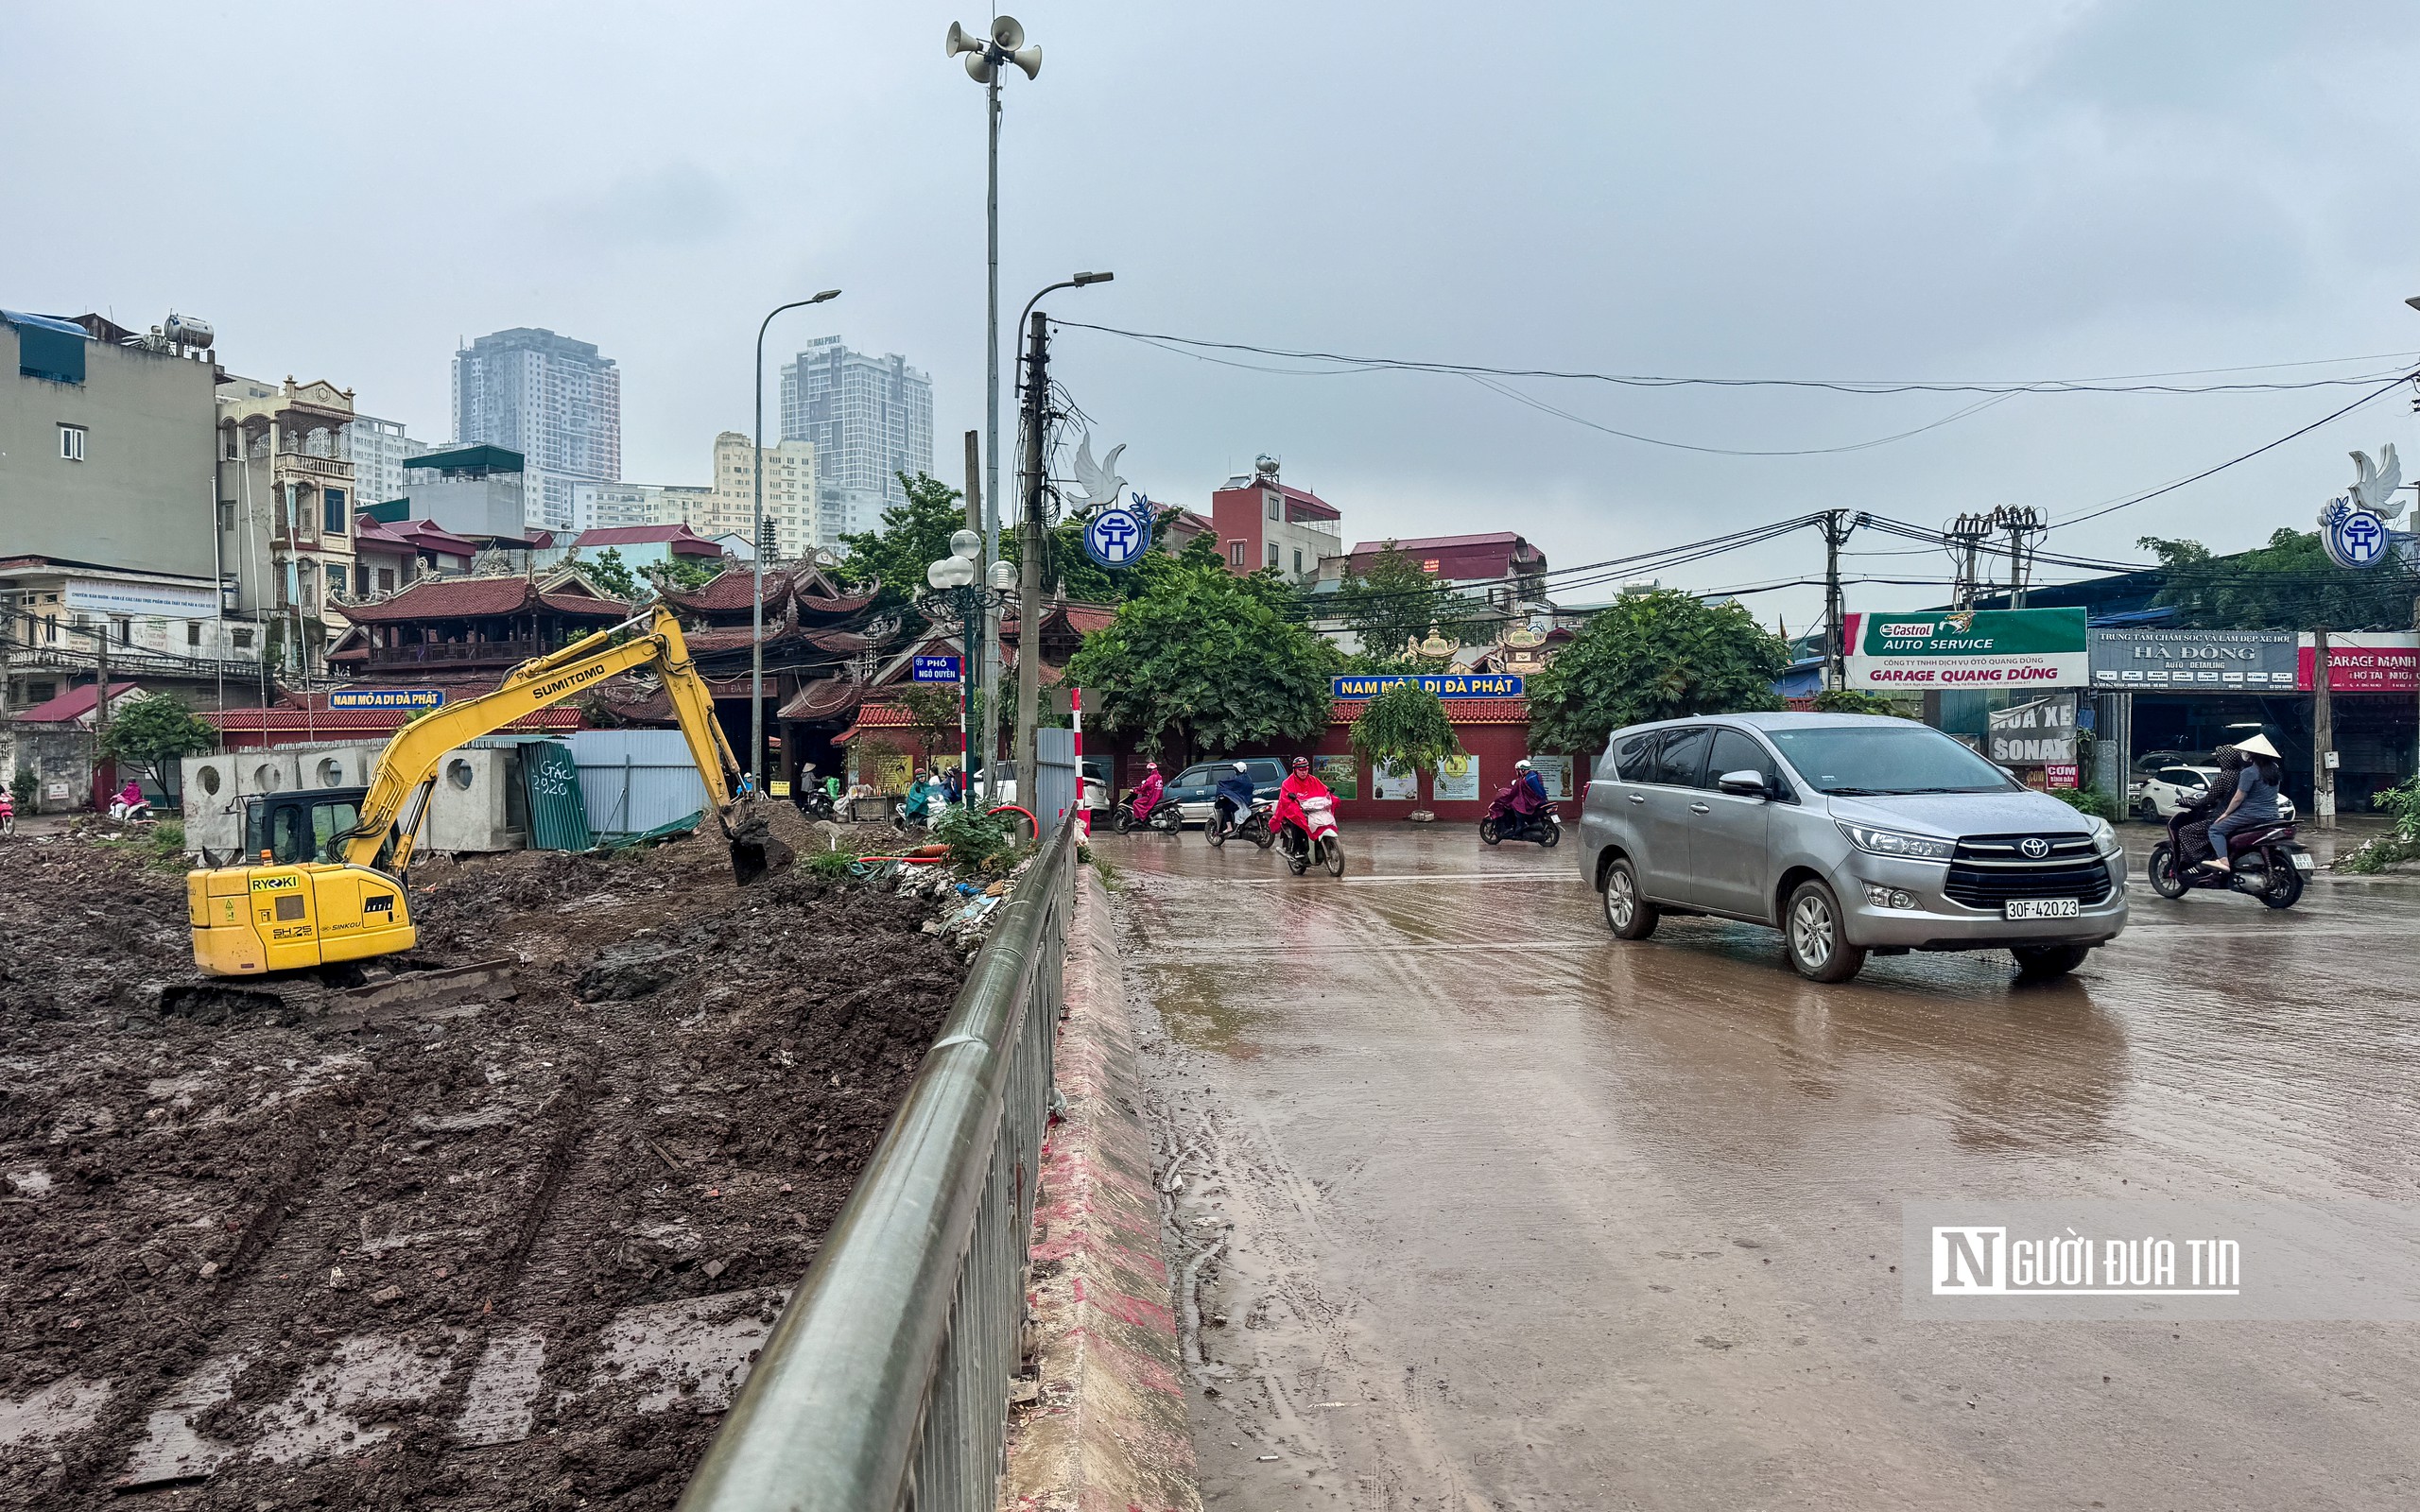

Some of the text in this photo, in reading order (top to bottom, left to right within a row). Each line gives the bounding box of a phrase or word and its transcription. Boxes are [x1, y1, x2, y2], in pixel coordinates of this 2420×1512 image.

[1893, 625, 1930, 636] Castrol
[2134, 632, 2153, 641] TÂM
[2155, 633, 2182, 642] CHĂM
[2183, 633, 2203, 642] SÓC
[2204, 633, 2217, 642] VÀ
[2219, 633, 2238, 642] LÀM
[1883, 639, 1994, 650] AUTO SERVICE
[2135, 643, 2256, 660] HÀ ĐÔNG
[927, 658, 947, 667] PHỐ
[2327, 656, 2417, 670] GARAGE MẠNH
[934, 667, 956, 679] QUYỀN
[1870, 666, 2058, 682] GARAGE QUANG DŨNG
[532, 664, 605, 699] SUMITOMO
[731, 682, 742, 693] ĐÀ
[747, 683, 768, 693] PT
[1341, 681, 1377, 695] NAM
[1425, 680, 1441, 693] DI
[1444, 677, 1467, 693] ĐÀ
[1472, 677, 1513, 696] PHẬT
[334, 691, 439, 707] NAM MÔ A DI ĐÀ PHẬT
[2045, 704, 2072, 728] XE
[1994, 738, 2071, 761] SONAX
[2048, 766, 2076, 776] CƠM
[2008, 901, 2077, 918] 30F-420.23
[332, 921, 361, 931] SINKOU
